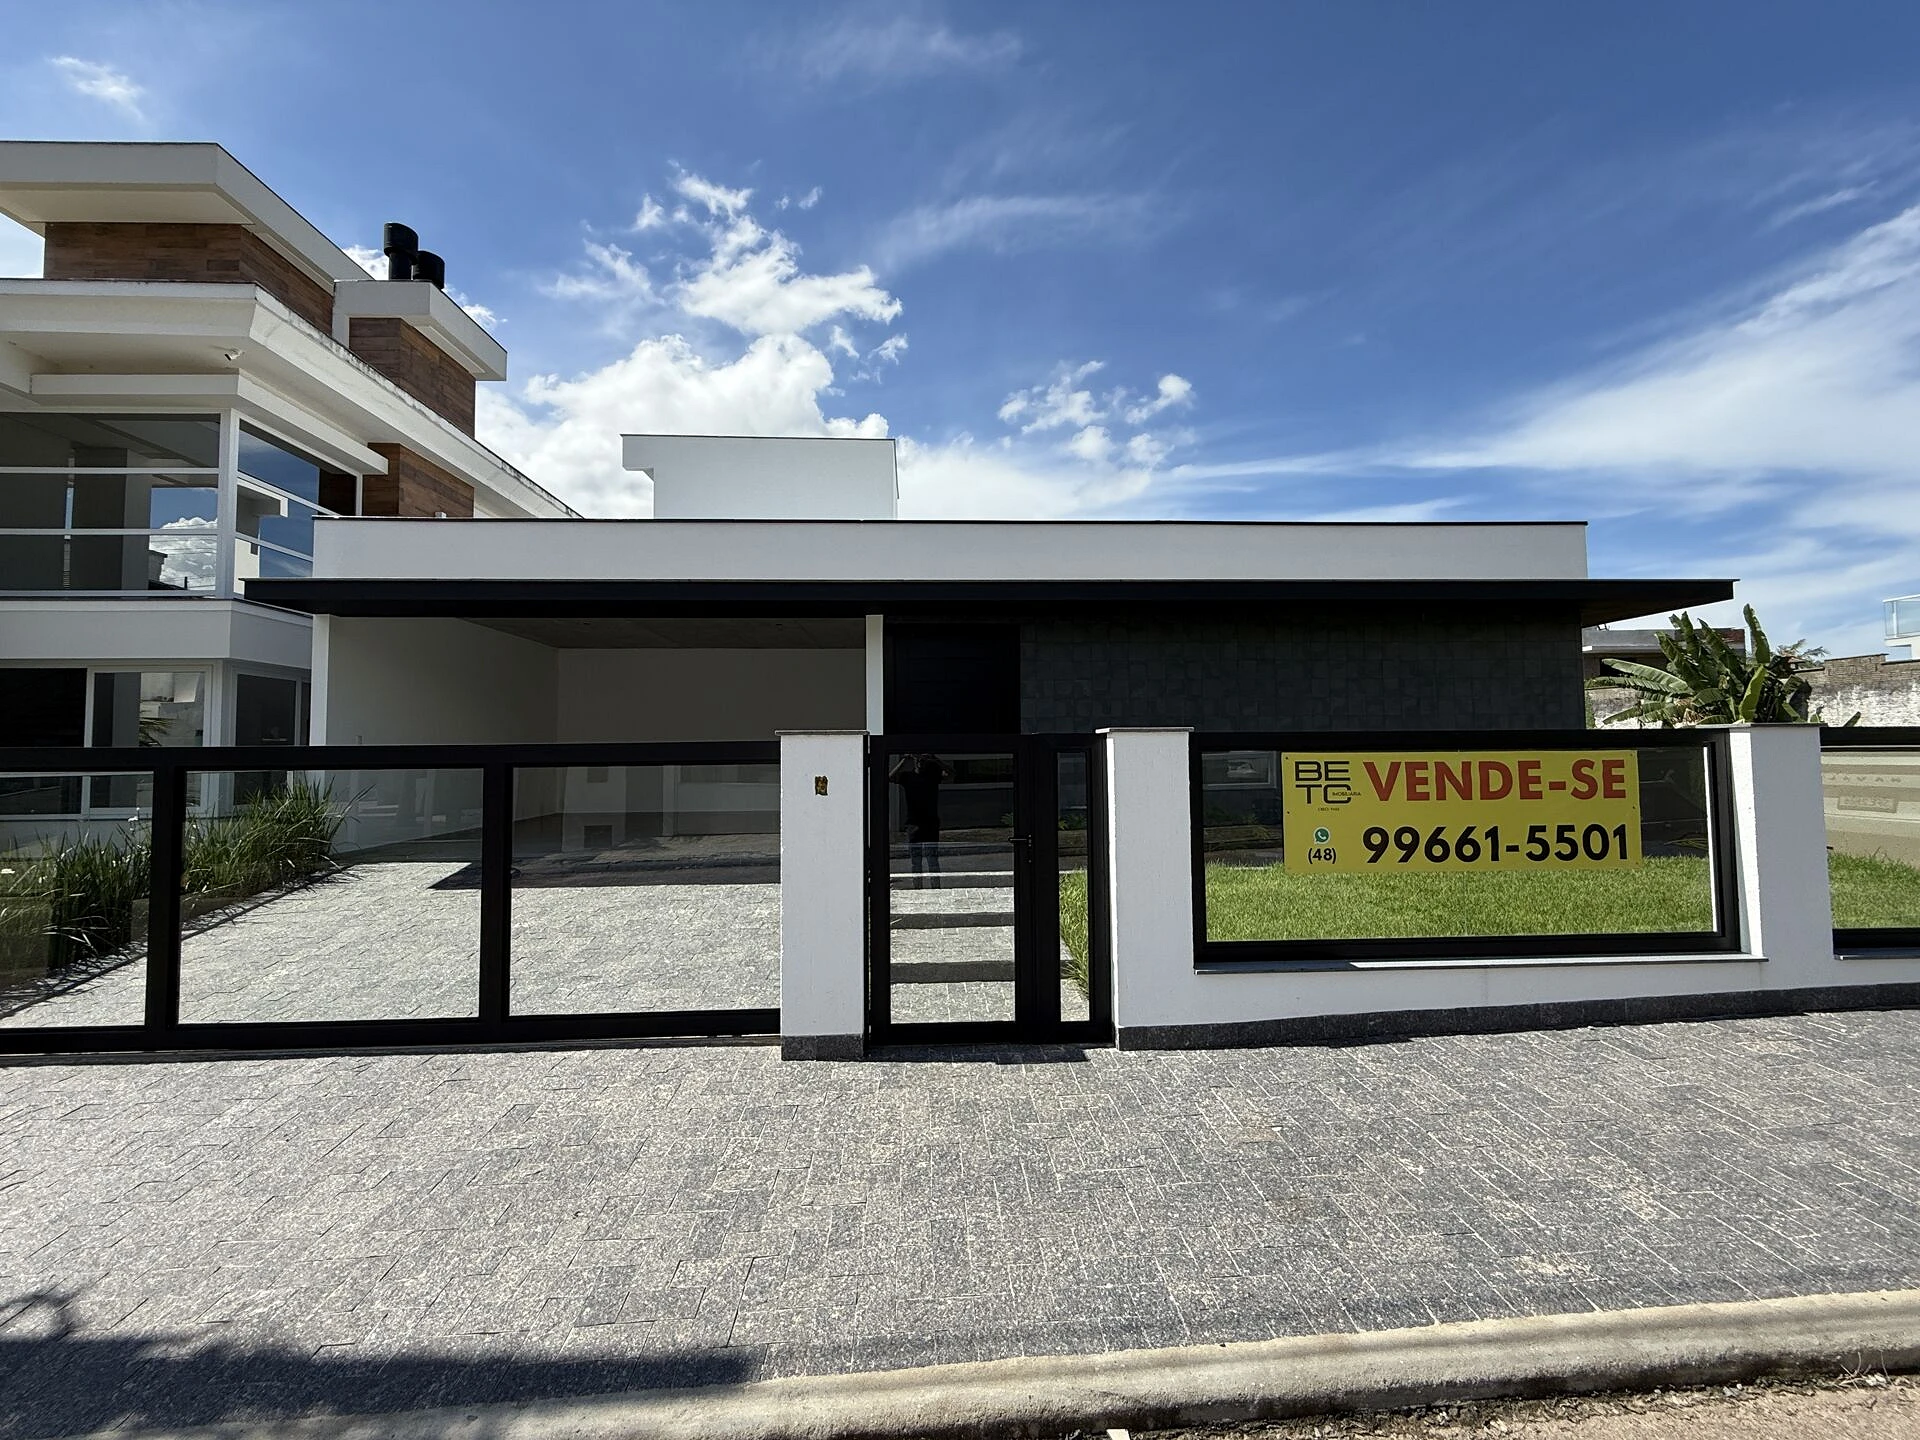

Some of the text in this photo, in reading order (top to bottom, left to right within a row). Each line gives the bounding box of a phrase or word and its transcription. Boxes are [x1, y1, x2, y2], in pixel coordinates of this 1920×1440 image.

[1295, 761, 1350, 781] BE
[1362, 759, 1627, 801] VENDE-SE
[1308, 848, 1336, 864] (48)
[1362, 824, 1628, 864] 99661-5501
